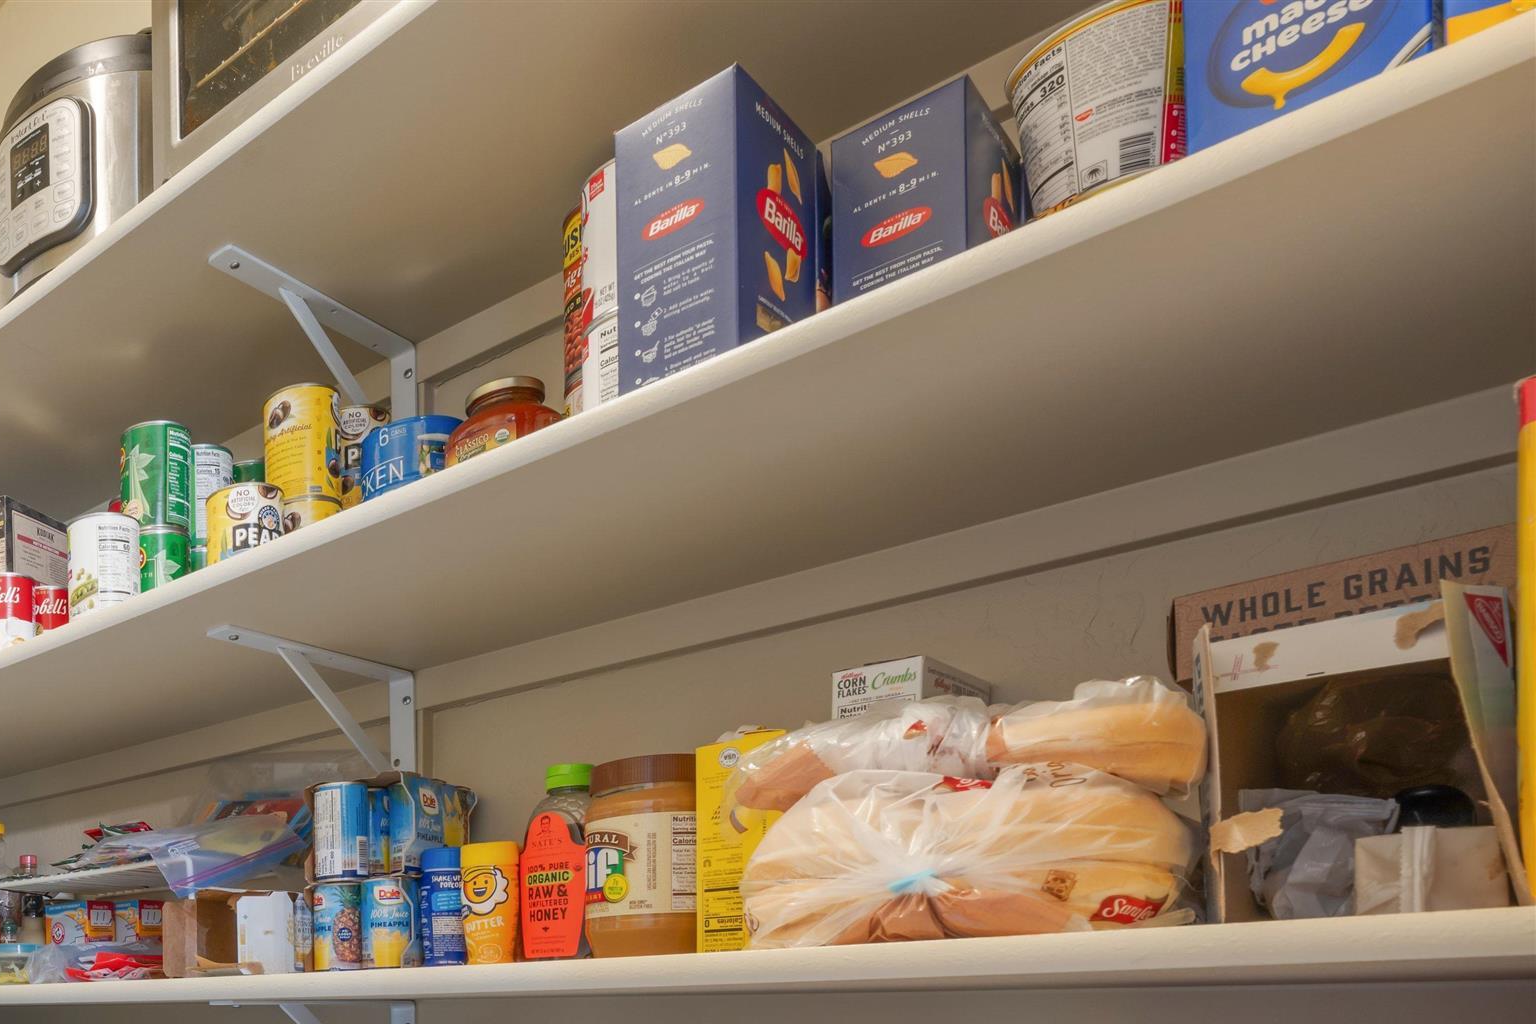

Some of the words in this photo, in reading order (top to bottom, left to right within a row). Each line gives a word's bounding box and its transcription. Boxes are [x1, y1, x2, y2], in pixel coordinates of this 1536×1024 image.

[1040, 75, 1065, 98] 320
[641, 110, 673, 137] MEDIUM
[675, 99, 703, 111] SHELLS
[755, 102, 782, 134] MEDIUM
[782, 129, 804, 160] SHELLS
[862, 120, 895, 146] MEDIUM
[899, 108, 931, 123] SHELLS
[898, 178, 917, 193] 8-9
[648, 203, 700, 238] Barilla
[764, 199, 803, 254] Barilla
[869, 211, 925, 244] Barilla
[348, 411, 362, 419] NO
[379, 428, 390, 447] 6
[36, 527, 55, 542] KODIAK
[1201, 581, 1327, 627] WHOLE
[1344, 546, 1491, 601] GRAINS
[837, 676, 866, 690] CORN
[871, 667, 917, 690] Crumbs
[838, 686, 867, 698] FLAKES
[527, 863, 546, 874] 100%
[548, 861, 569, 871] PURE
[527, 870, 570, 885] ORGANIC
[378, 888, 401, 900] Dole
[528, 886, 552, 901] RAW
[557, 884, 568, 897] &
[528, 898, 569, 908] UNFILTERED
[371, 909, 389, 919] 100%
[529, 907, 567, 923] HONEY
[371, 921, 409, 929] PINEAPPLE
